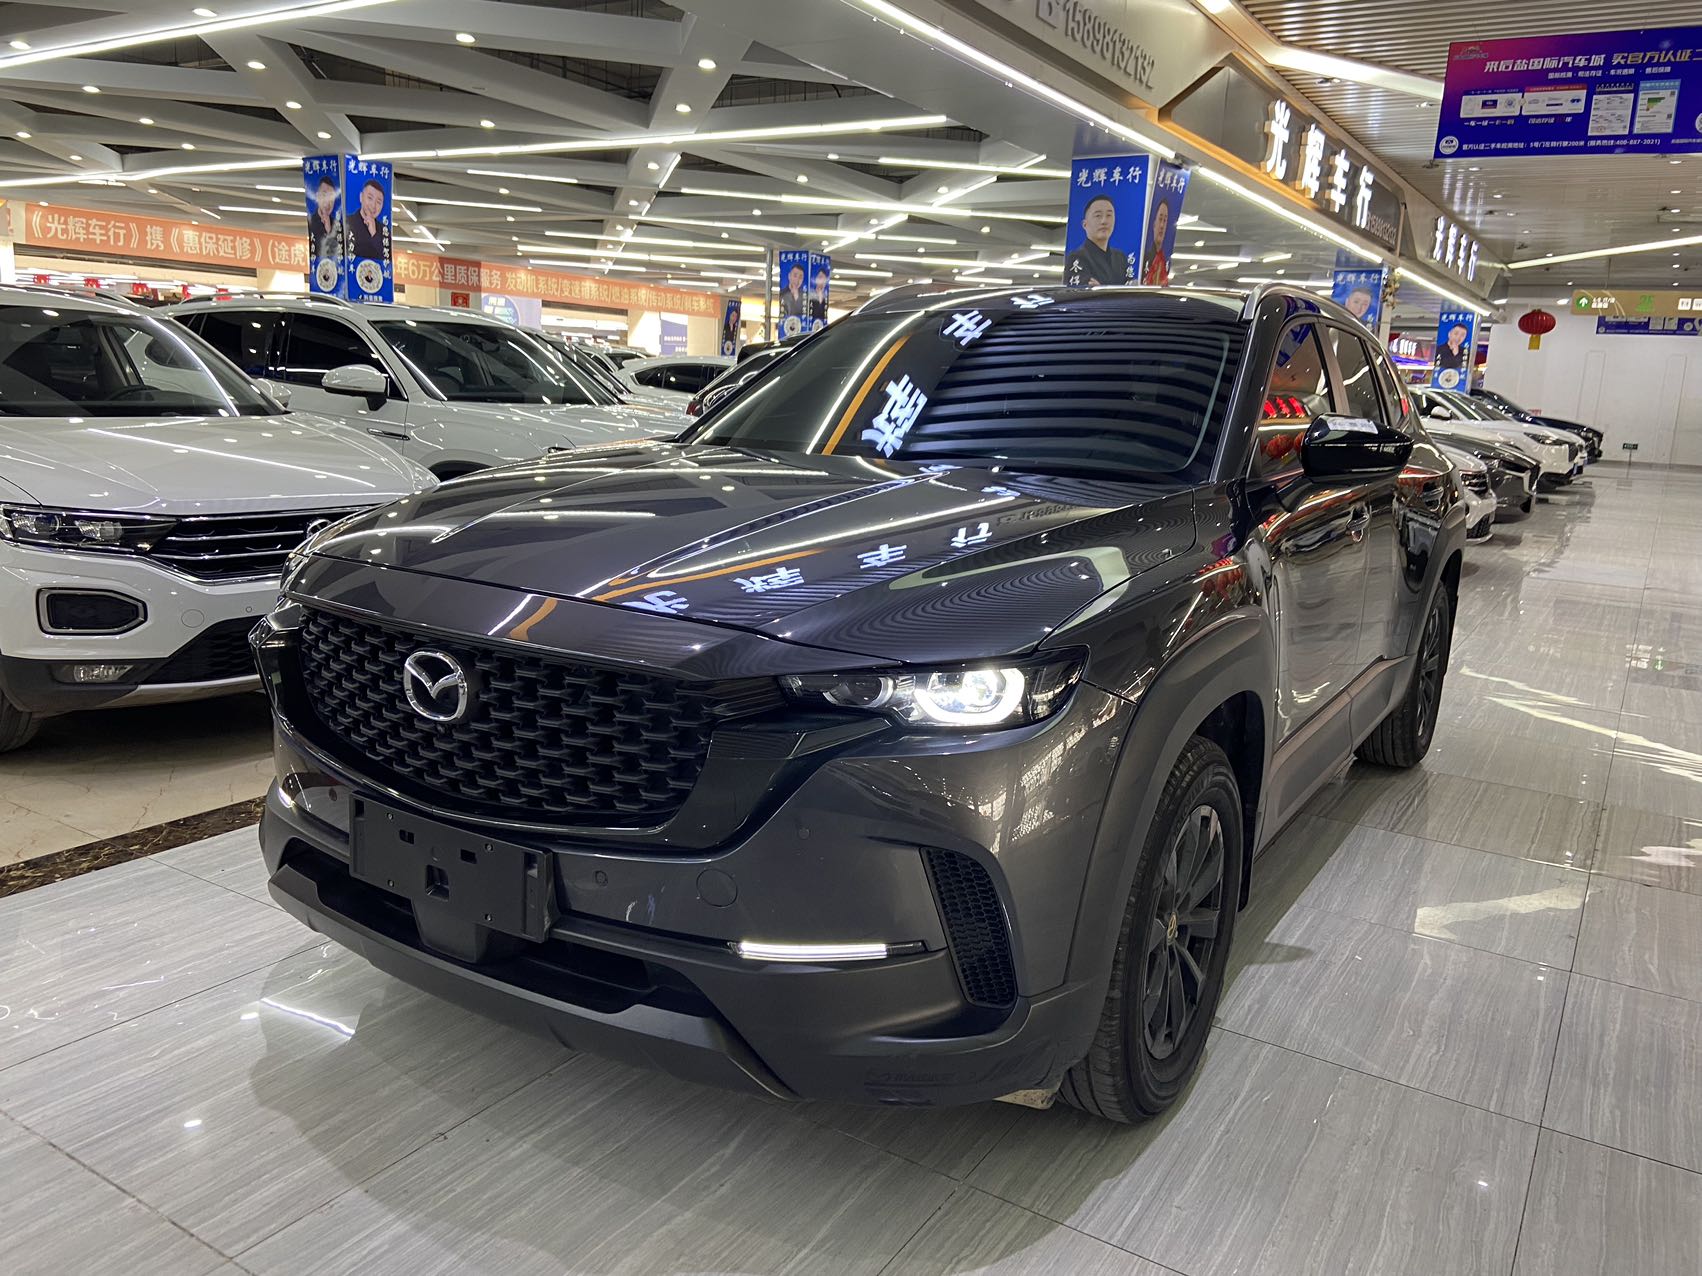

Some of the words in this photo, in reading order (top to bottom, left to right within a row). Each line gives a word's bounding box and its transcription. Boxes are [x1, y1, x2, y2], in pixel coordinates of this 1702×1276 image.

[1064, 0, 1155, 90] 15898132132
[305, 160, 337, 174] 光辉车行
[348, 160, 389, 179] 光辉车行
[1266, 98, 1375, 229] 光辉车行
[1077, 166, 1142, 188] 光辉车行
[1158, 168, 1185, 194] 光辉车行
[1336, 272, 1380, 285] 光辉车行
[1441, 313, 1473, 322] 光辉车行
